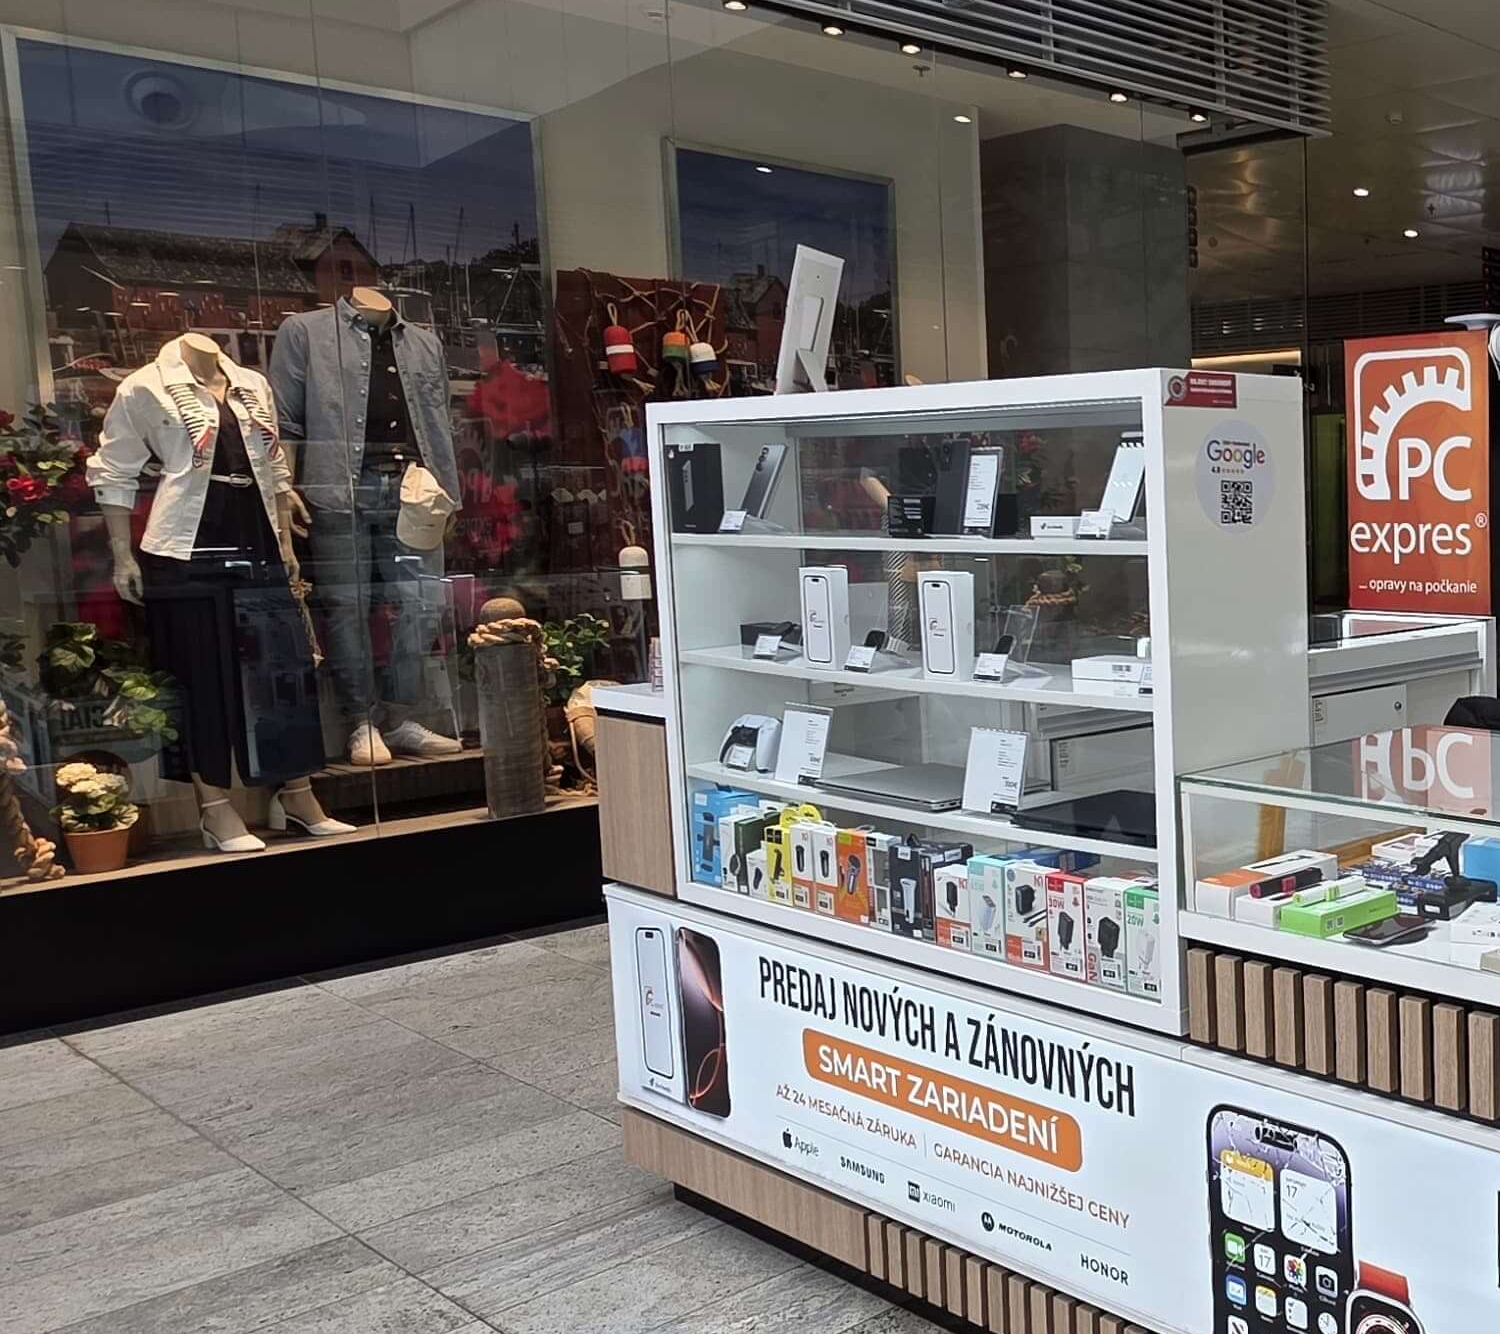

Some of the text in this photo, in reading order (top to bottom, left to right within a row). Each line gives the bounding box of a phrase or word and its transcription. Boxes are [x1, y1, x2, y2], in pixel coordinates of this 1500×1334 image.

[1207, 440, 1265, 469] Google
[1399, 436, 1472, 501] PC
[1351, 521, 1472, 565] expres
[1369, 578, 1406, 594] opravy
[1409, 580, 1423, 591] na
[1425, 579, 1477, 595] počkanie
[1088, 953, 1098, 981] GaN
[759, 956, 1135, 1117] PREDAJ NOVÝCH A ZÁNOVNÝCH
[819, 1045, 1059, 1154] SMART ZARIADENÍ
[776, 1084, 917, 1149] AŽ 24 MESAČNÁ ZÁRUKA
[794, 1136, 820, 1157] Apple
[840, 1156, 885, 1184] SAMSUNG
[934, 1142, 1130, 1229] GARANCIA NAJNIŽŠEJ CENY
[922, 1192, 956, 1212] xiaomi
[998, 1223, 1052, 1251] MOTOROLA
[1080, 1253, 1129, 1285] HONOR
